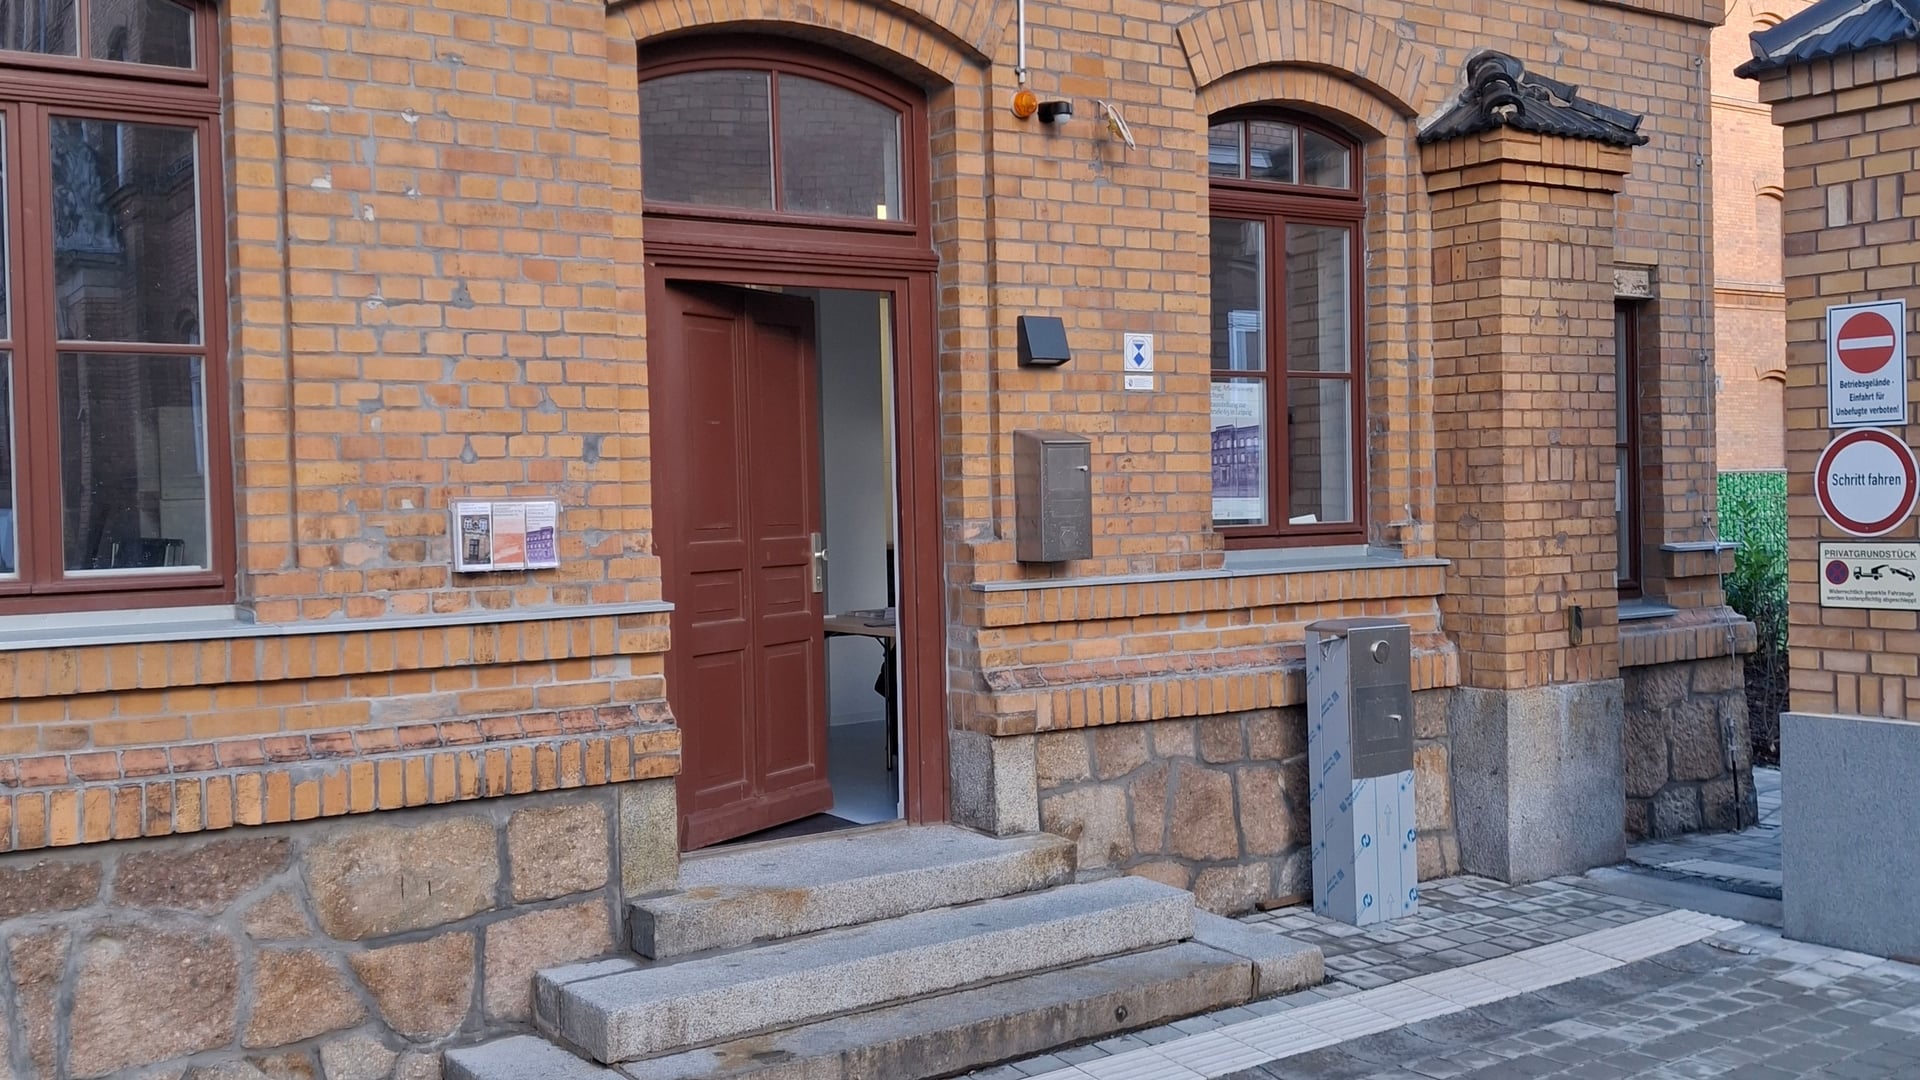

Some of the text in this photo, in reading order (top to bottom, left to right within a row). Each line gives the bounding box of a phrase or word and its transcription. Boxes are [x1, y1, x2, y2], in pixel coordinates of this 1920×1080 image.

[1840, 378, 1890, 389] Betriebsgelände
[1849, 392, 1885, 401] Einfahrt für
[1836, 405, 1900, 417] Unbefugte verboten!
[1832, 473, 1902, 486] Schritt fahren
[1824, 548, 1917, 559] PRIVATGRUNDSTÜCK
